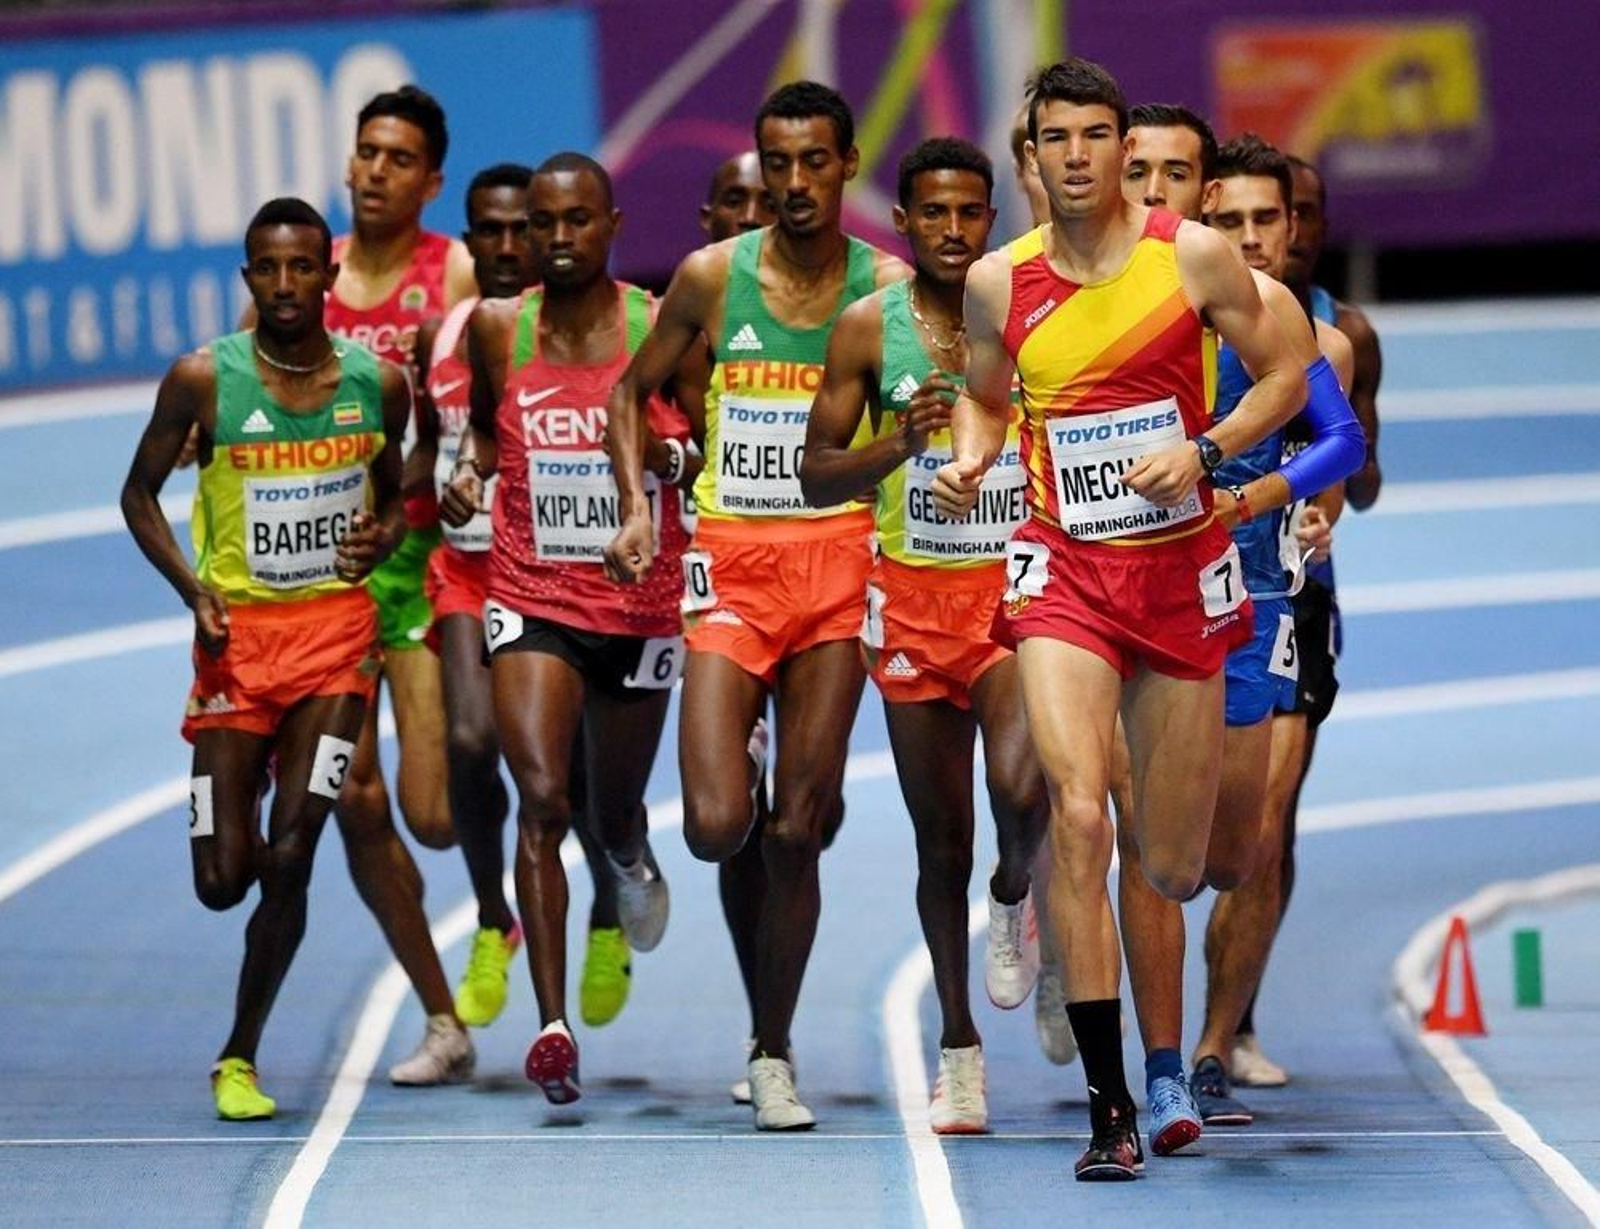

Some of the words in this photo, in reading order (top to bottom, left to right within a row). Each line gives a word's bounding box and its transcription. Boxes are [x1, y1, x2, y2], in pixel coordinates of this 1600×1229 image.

[723, 361, 826, 391] ETHIO
[728, 407, 778, 425] TOYO
[1055, 425, 1113, 446] TOYO
[1114, 409, 1179, 438] TIRES
[537, 462, 591, 476] TOYO
[254, 486, 310, 502] TOYO
[314, 473, 363, 497] TIRES
[1069, 509, 1170, 537] BIRMINGHAM
[912, 538, 1006, 555] BIRMINGHAM
[256, 565, 333, 583] BIRMINGHA
[1013, 553, 1034, 589] 7
[1214, 561, 1232, 603] 7
[1282, 629, 1296, 668] 5
[653, 647, 674, 682] 6
[327, 753, 349, 790] 3
